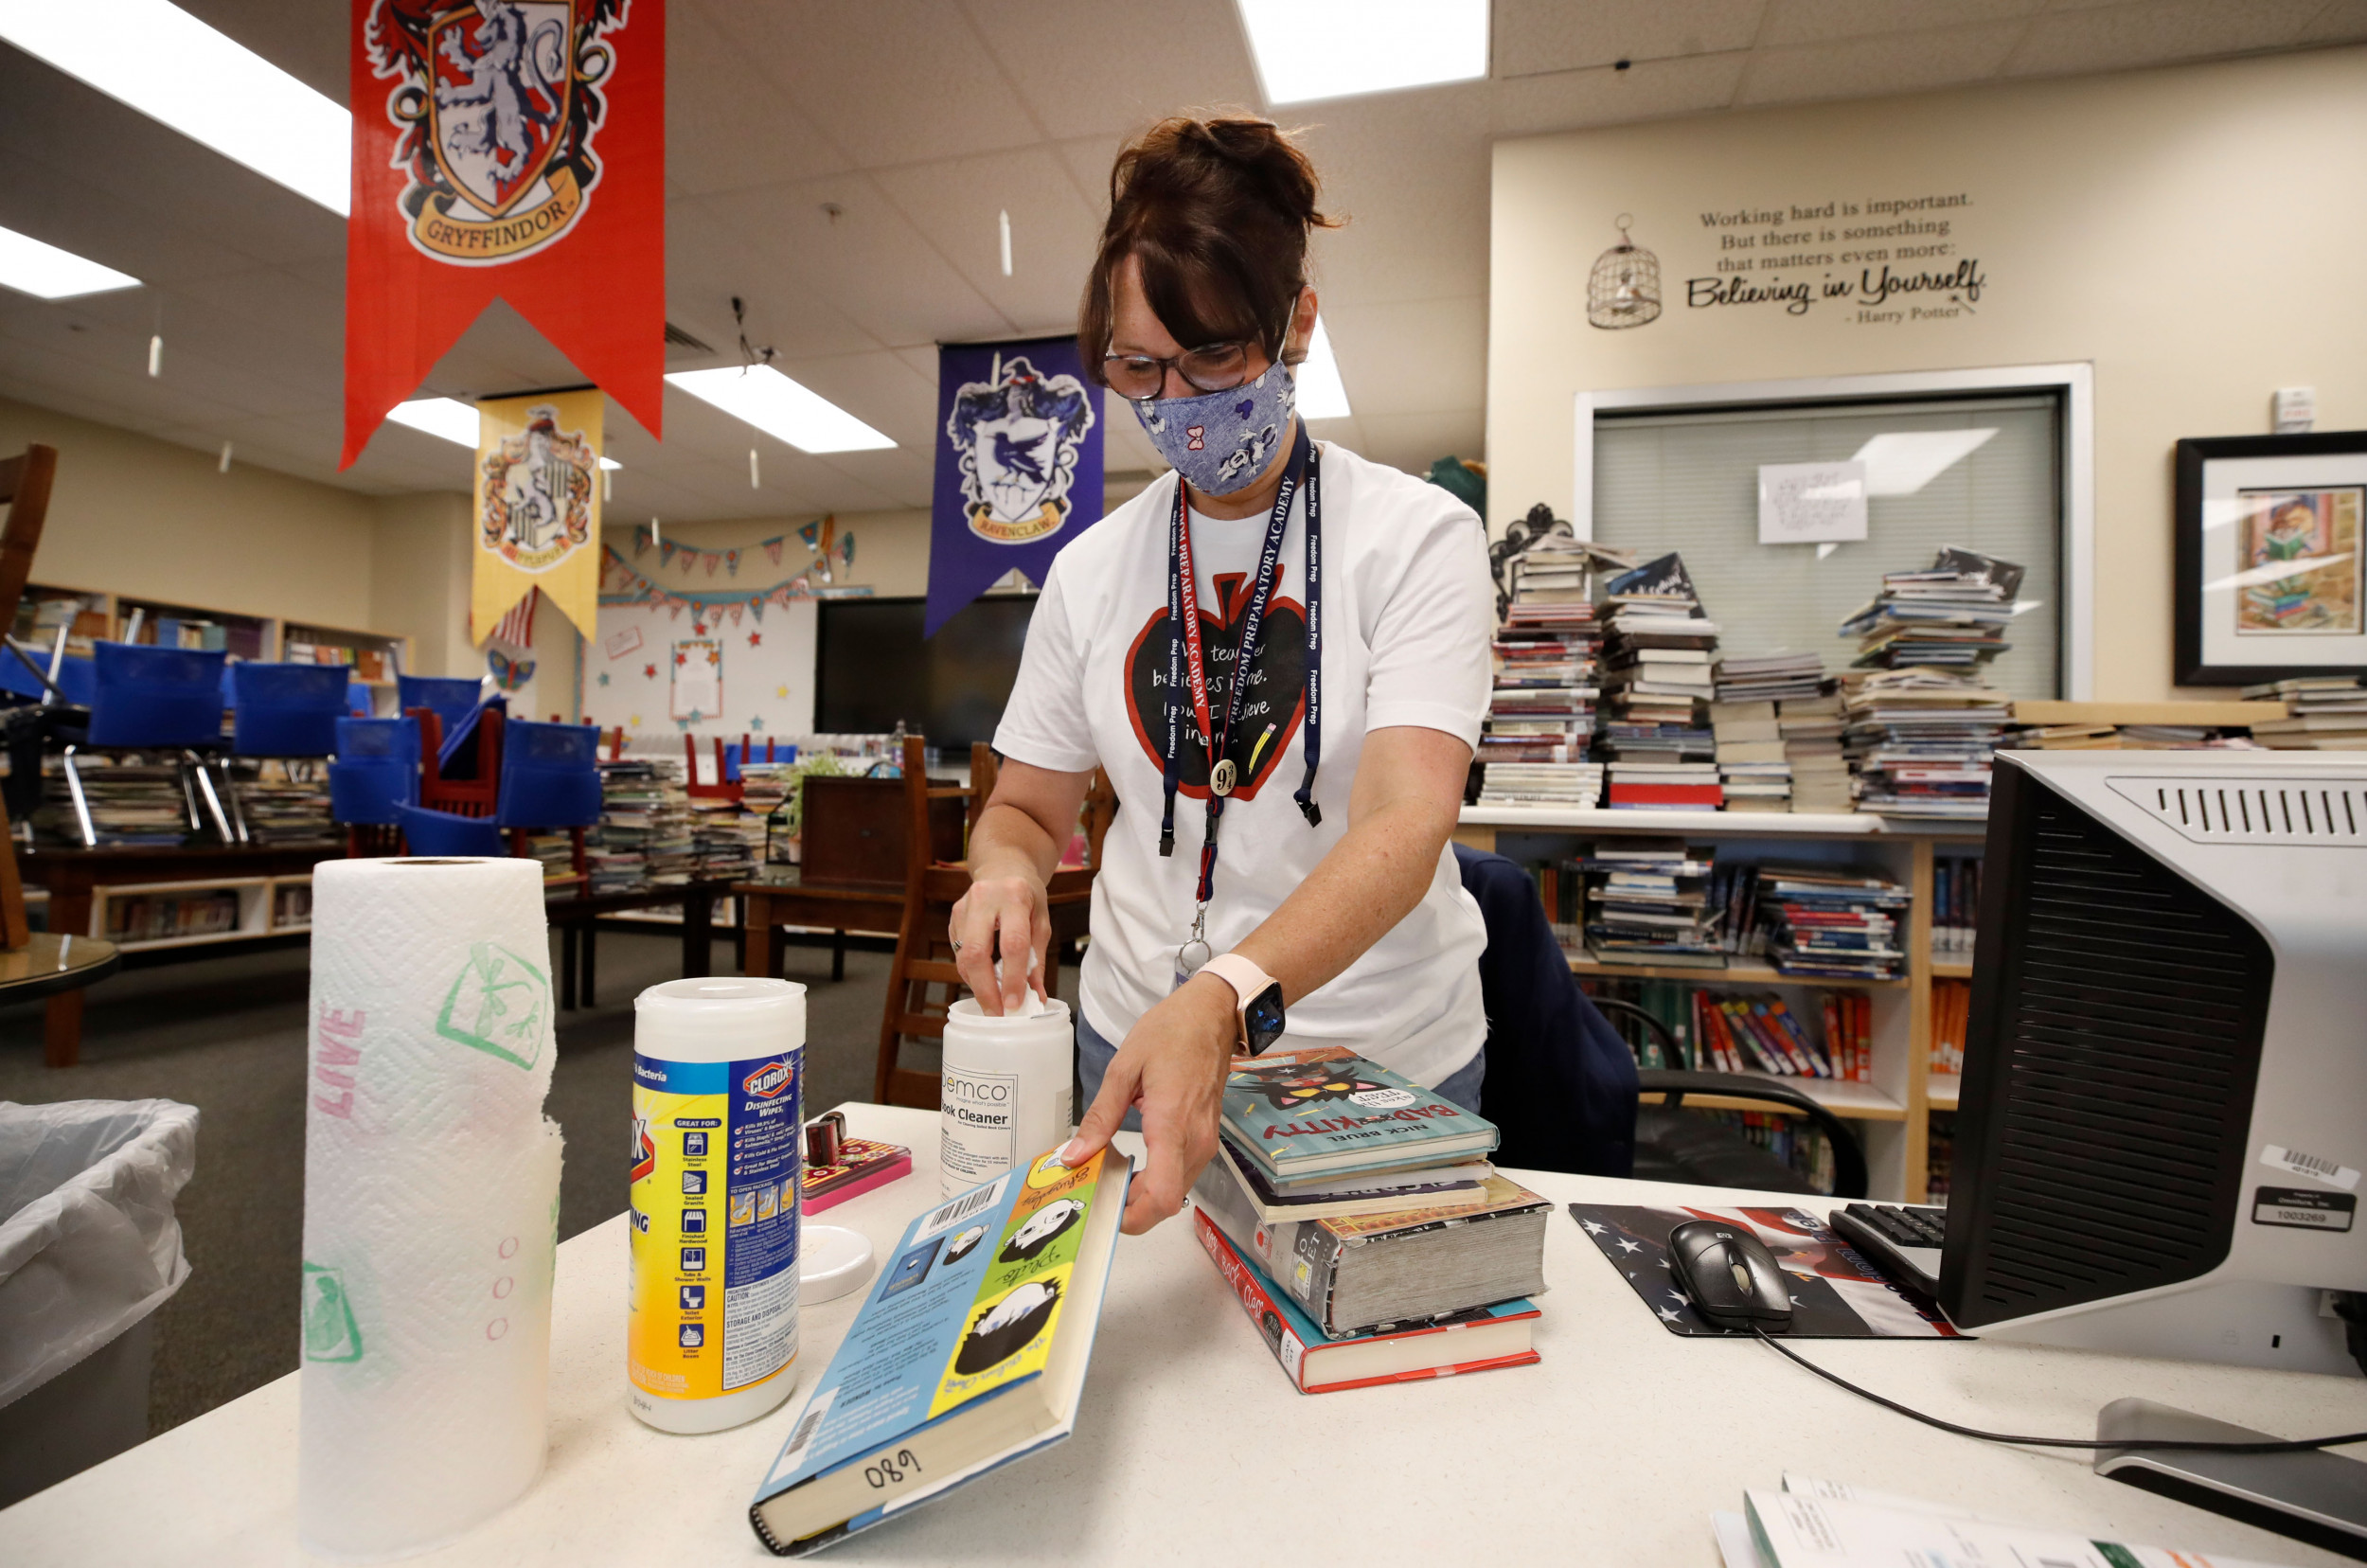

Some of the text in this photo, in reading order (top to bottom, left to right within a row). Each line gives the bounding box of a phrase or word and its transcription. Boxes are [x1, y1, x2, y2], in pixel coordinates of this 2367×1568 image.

[1700, 193, 1973, 226] Working hard is important.
[427, 201, 567, 248] GRYFFINDOR
[1720, 218, 1950, 250] But there is something
[1717, 242, 1955, 272] that matters even more:
[1685, 276, 1817, 315] Believing
[1823, 273, 1853, 298] in
[1857, 310, 1905, 325] Harry
[1911, 307, 1961, 320] Potter
[1308, 502, 1317, 517] Prep
[980, 518, 1051, 537] RAVENCLAW
[1308, 566, 1317, 582] Prep
[1230, 475, 1294, 724] FREEDOM PREPARATORY ACADEMY
[1179, 543, 1198, 638] PREPARATORY
[1189, 643, 1205, 707] ACADEMY
[1308, 600, 1318, 650] Freedom Prep
[1170, 638, 1179, 655] Prep
[1169, 706, 1178, 723] Prep
[1308, 706, 1318, 725] Prep
[314, 1001, 365, 1120] LIVE
[638, 1064, 667, 1081] Bacteria
[750, 1065, 790, 1095] CLOROX
[744, 1094, 792, 1111] DISINFECTING
[958, 1108, 1007, 1125] Cleaner
[1263, 1104, 1461, 1139] BAD KITTY
[1327, 1124, 1430, 1142] NICK BRUEL
[2277, 1210, 2326, 1222] 1003269
[1244, 1285, 1264, 1319] Class
[727, 1312, 761, 1328] STORAGE AND
